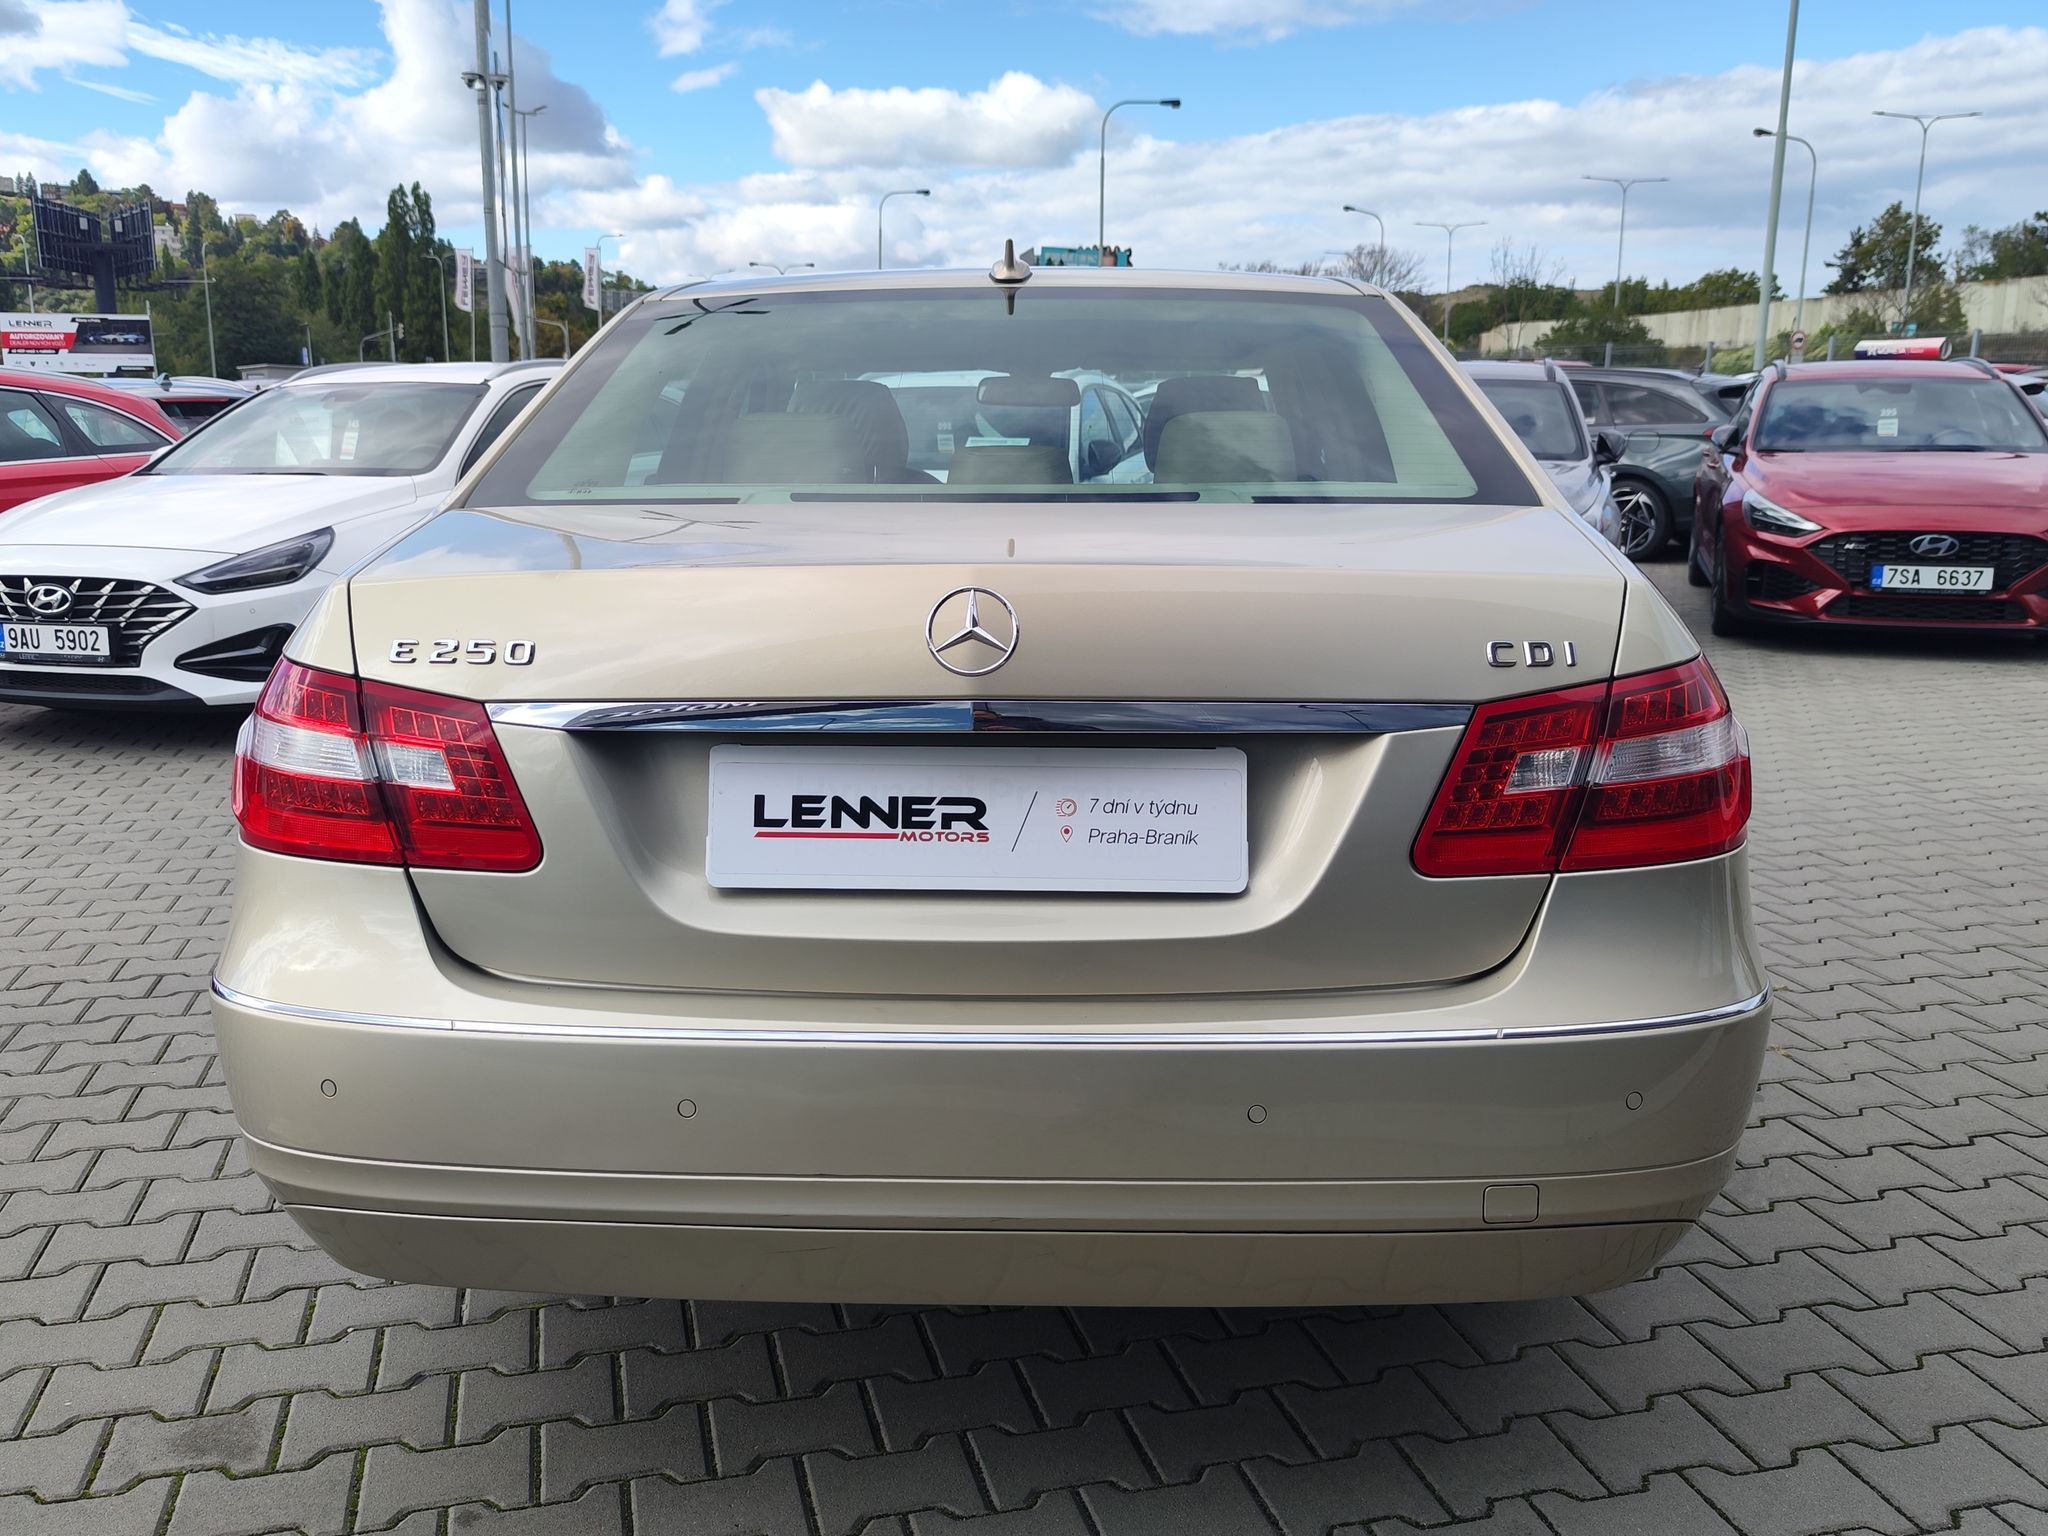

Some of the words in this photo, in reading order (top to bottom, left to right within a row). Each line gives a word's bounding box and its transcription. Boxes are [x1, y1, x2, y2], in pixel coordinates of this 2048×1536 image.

[8, 320, 53, 328] LENNER
[1887, 568, 1920, 585] 7SA
[1937, 569, 1984, 587] 6637
[8, 627, 41, 649] 9AU
[54, 629, 101, 651] 5902
[388, 639, 419, 664] E
[428, 639, 536, 666] 250
[1486, 640, 1577, 667] CDI
[753, 794, 990, 831] LENNER
[1090, 798, 1100, 813] 7
[1103, 799, 1131, 814] dní
[1134, 803, 1145, 814] v
[1149, 799, 1198, 818] týdnu
[899, 831, 990, 843] MOTORS
[1088, 828, 1199, 845] Praha-Braník
